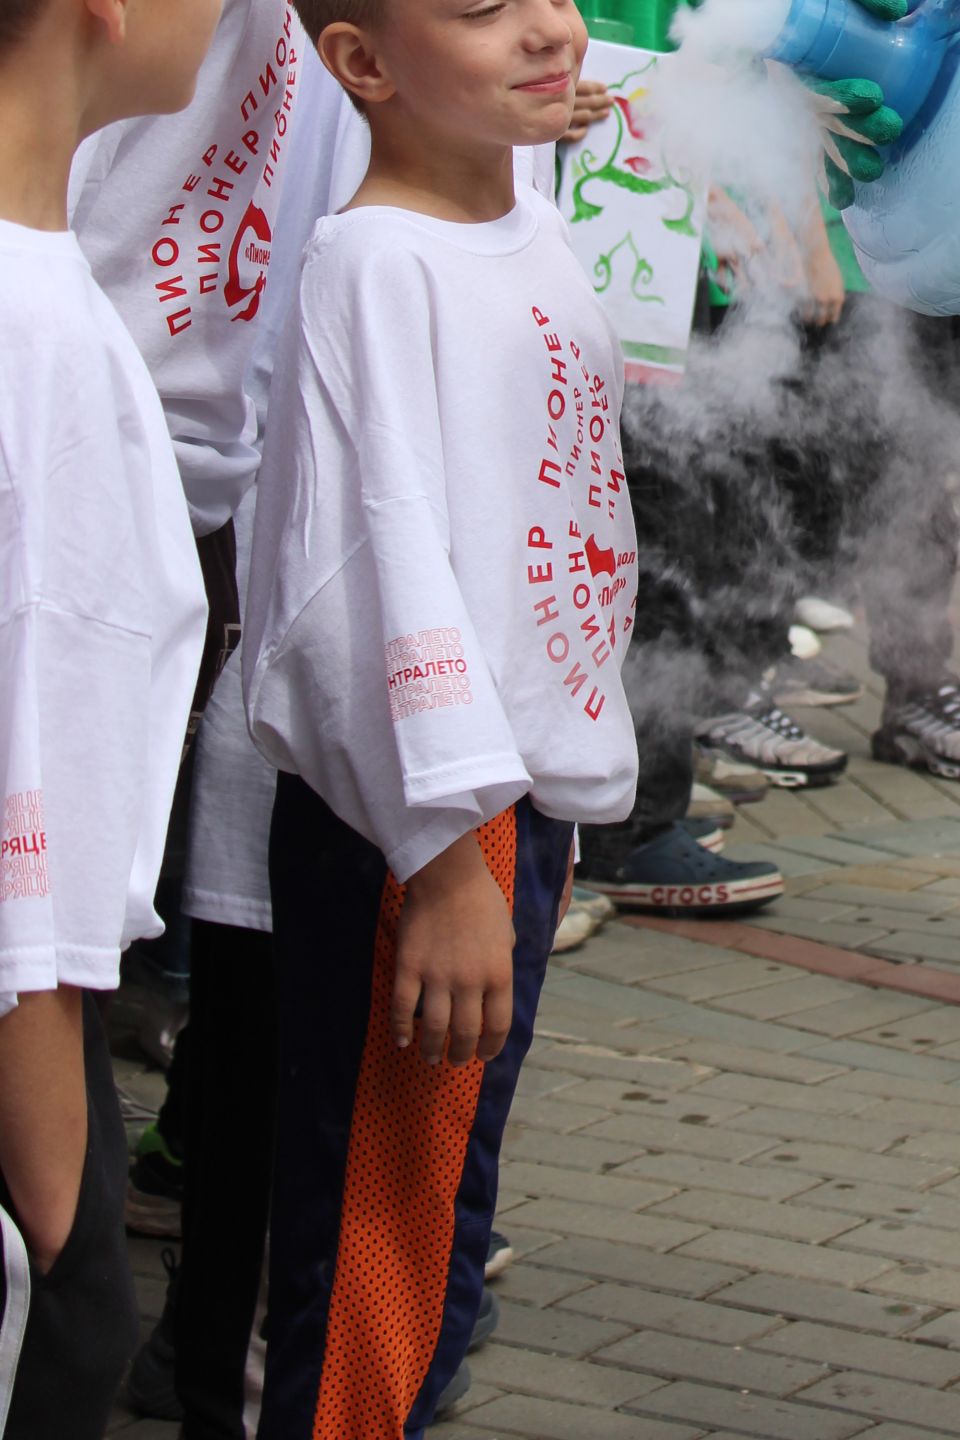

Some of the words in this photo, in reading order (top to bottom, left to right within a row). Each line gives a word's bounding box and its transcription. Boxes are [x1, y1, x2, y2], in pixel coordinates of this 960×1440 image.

[262, 47, 297, 188] ПИОНЕР
[152, 143, 218, 337] ПИОНЕР
[197, 129, 260, 295] ПИОНЕР
[531, 306, 567, 489] ПИОНЕР
[565, 387, 584, 477] ПИОНЕР
[528, 526, 605, 721] ПИОНЕР
[568, 520, 611, 668] ПИОНЕ
[388, 659, 467, 689] НТРАЛЕТО
[651, 885, 729, 905] crocs
